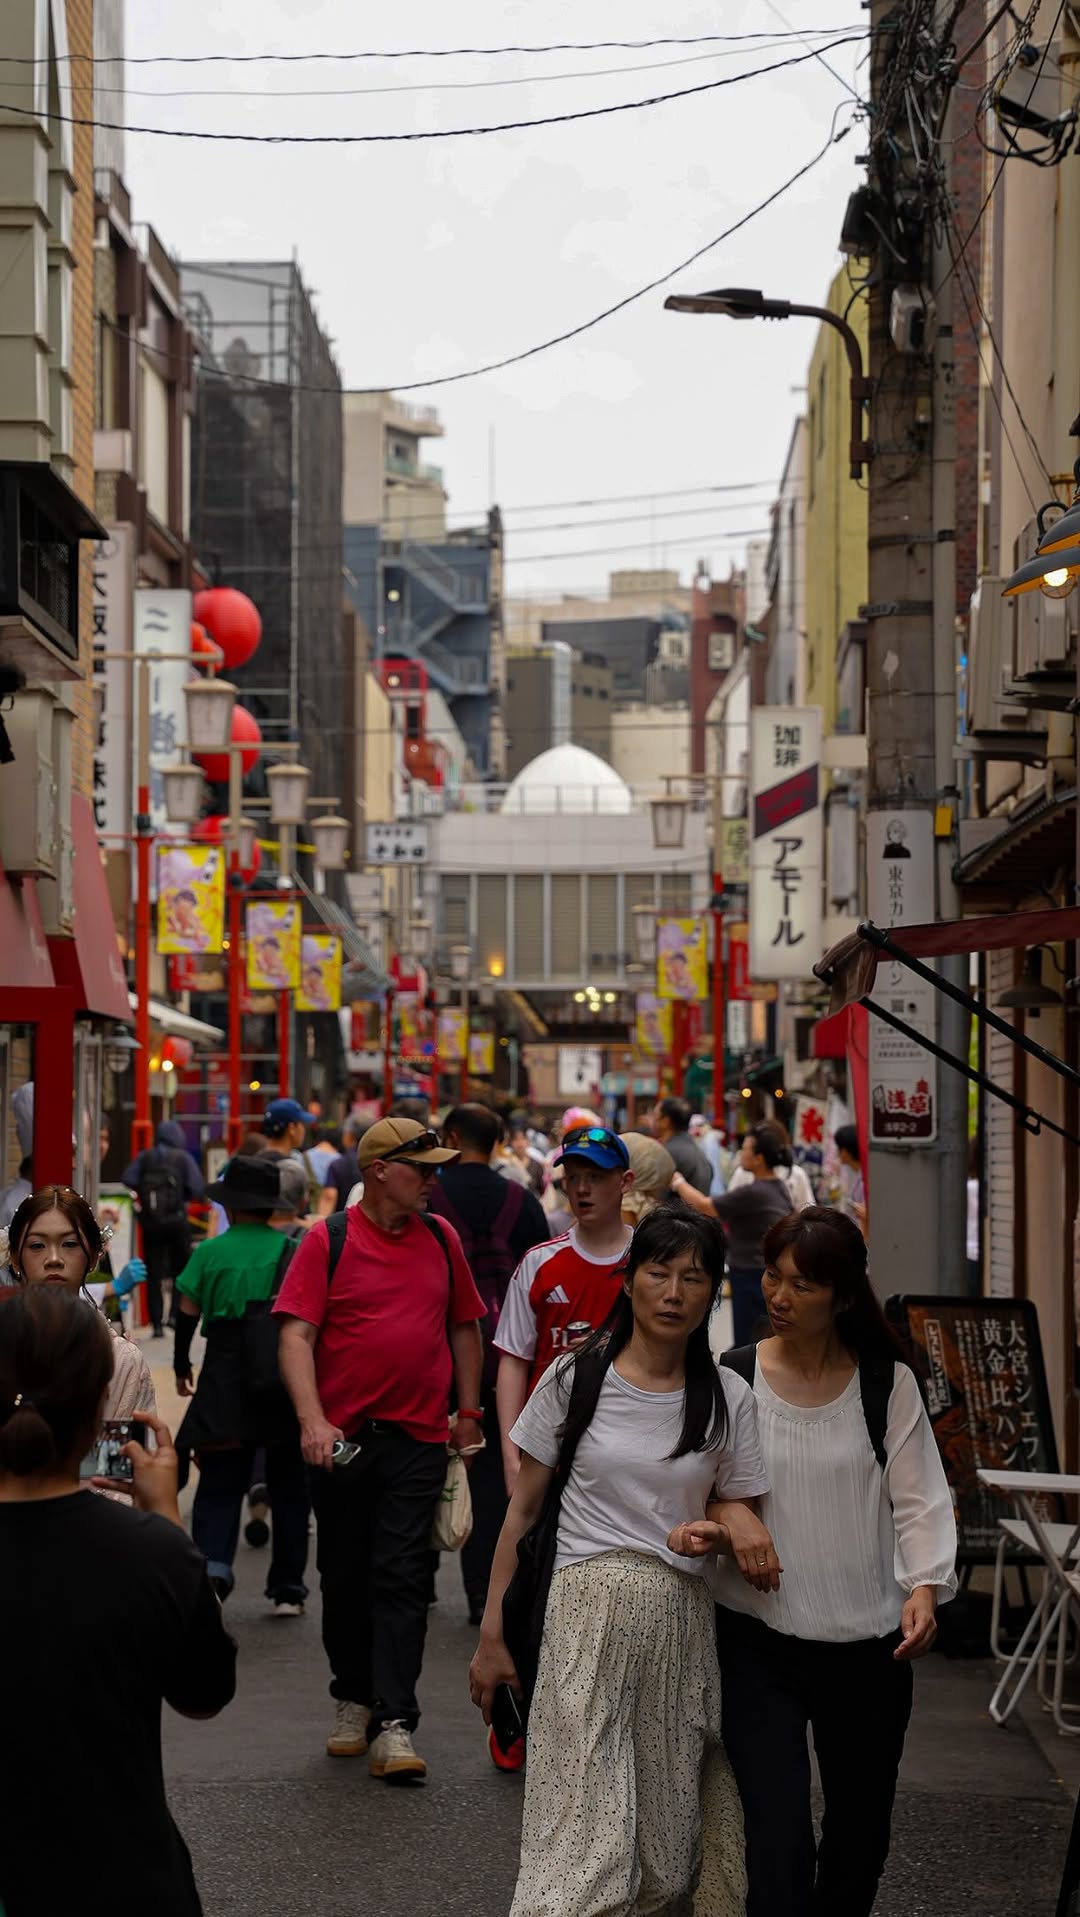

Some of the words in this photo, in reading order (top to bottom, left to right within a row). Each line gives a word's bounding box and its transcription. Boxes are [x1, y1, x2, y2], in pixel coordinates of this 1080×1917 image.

[773, 724, 800, 768] 珈琲
[771, 837, 805, 946] アモール
